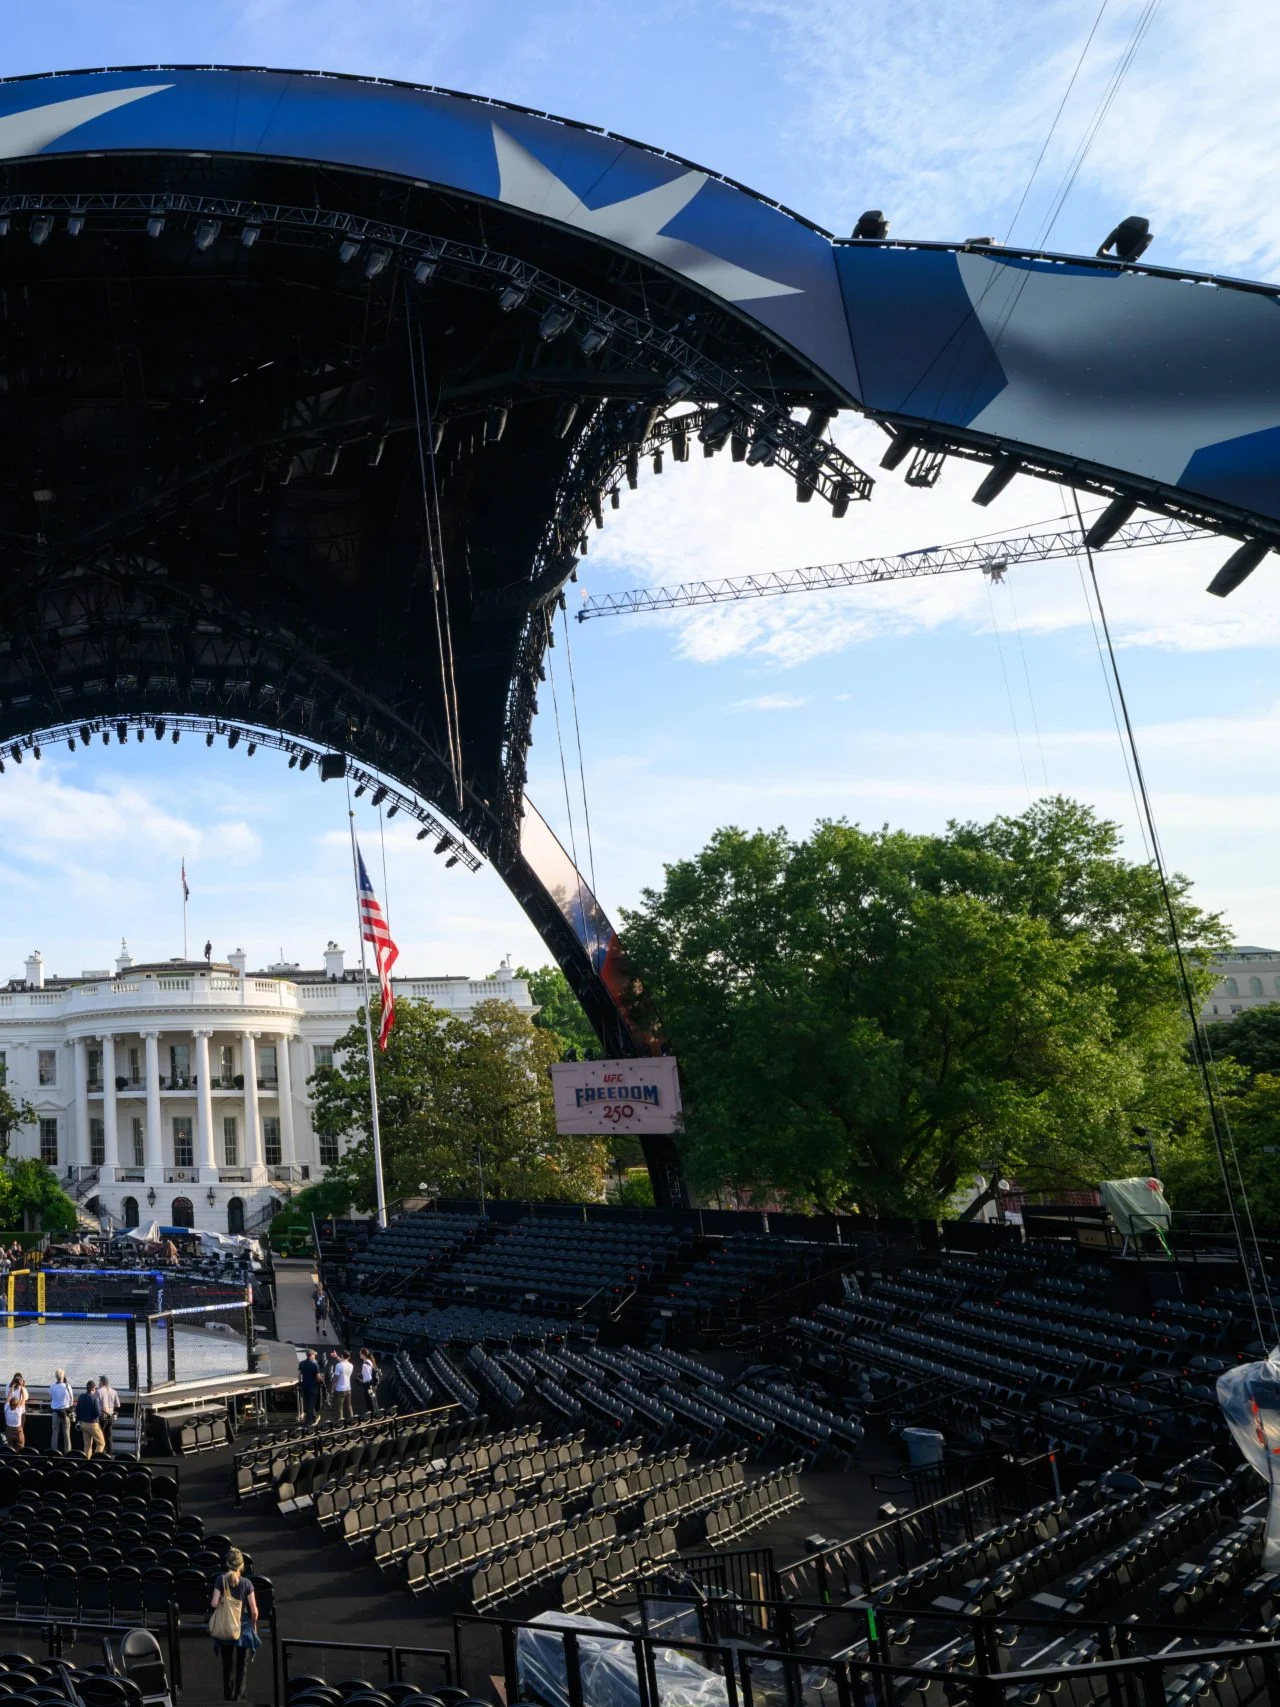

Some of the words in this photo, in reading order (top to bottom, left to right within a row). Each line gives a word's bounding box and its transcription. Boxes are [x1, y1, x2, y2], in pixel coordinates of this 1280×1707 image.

[603, 1073, 624, 1083] UFC
[575, 1085, 660, 1108] FREEDOM
[603, 1104, 634, 1123] 250
